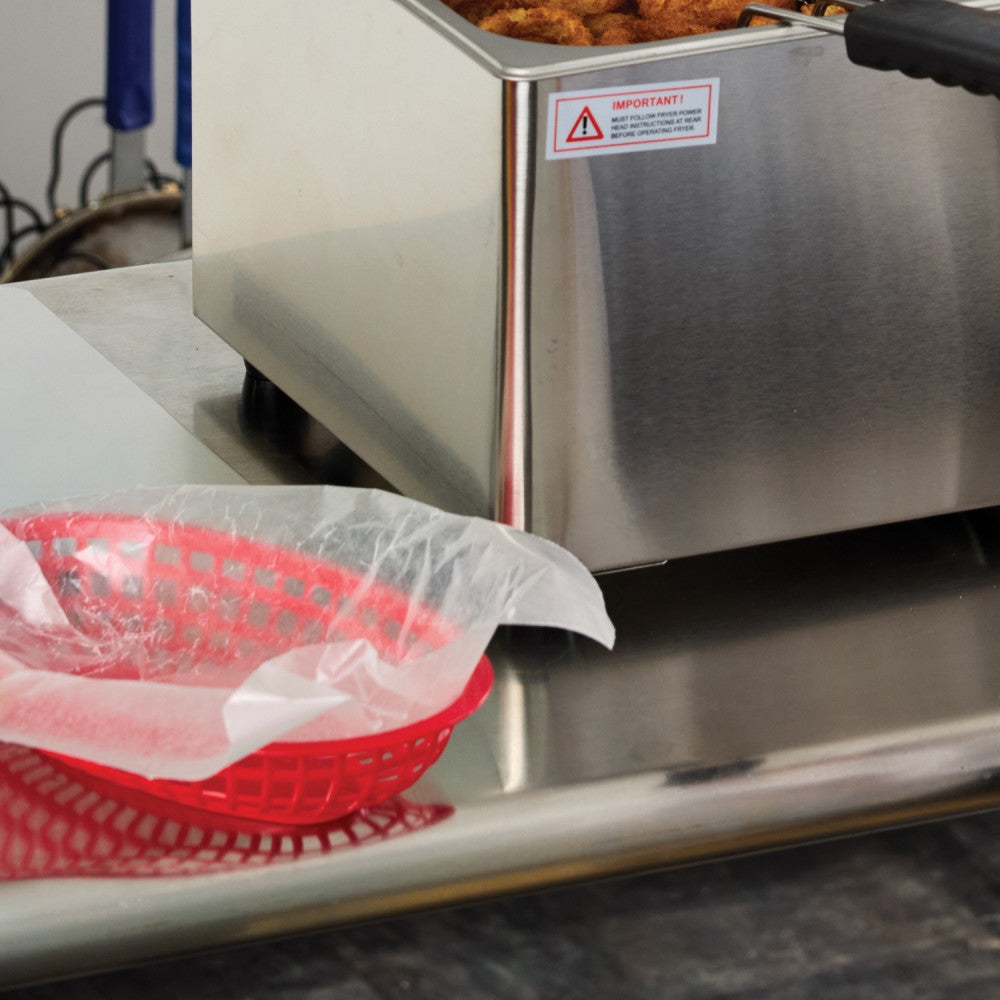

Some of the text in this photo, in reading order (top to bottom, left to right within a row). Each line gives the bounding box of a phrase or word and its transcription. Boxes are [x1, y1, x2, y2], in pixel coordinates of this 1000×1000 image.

[611, 115, 629, 123] MUST
[630, 113, 656, 121] FOLLOW
[679, 108, 702, 116] POWER
[611, 123, 628, 131] HEAD
[630, 119, 675, 129] INSTRUCTIONS
[611, 131, 636, 139] BEFORE
[637, 128, 673, 136] OPERATING
